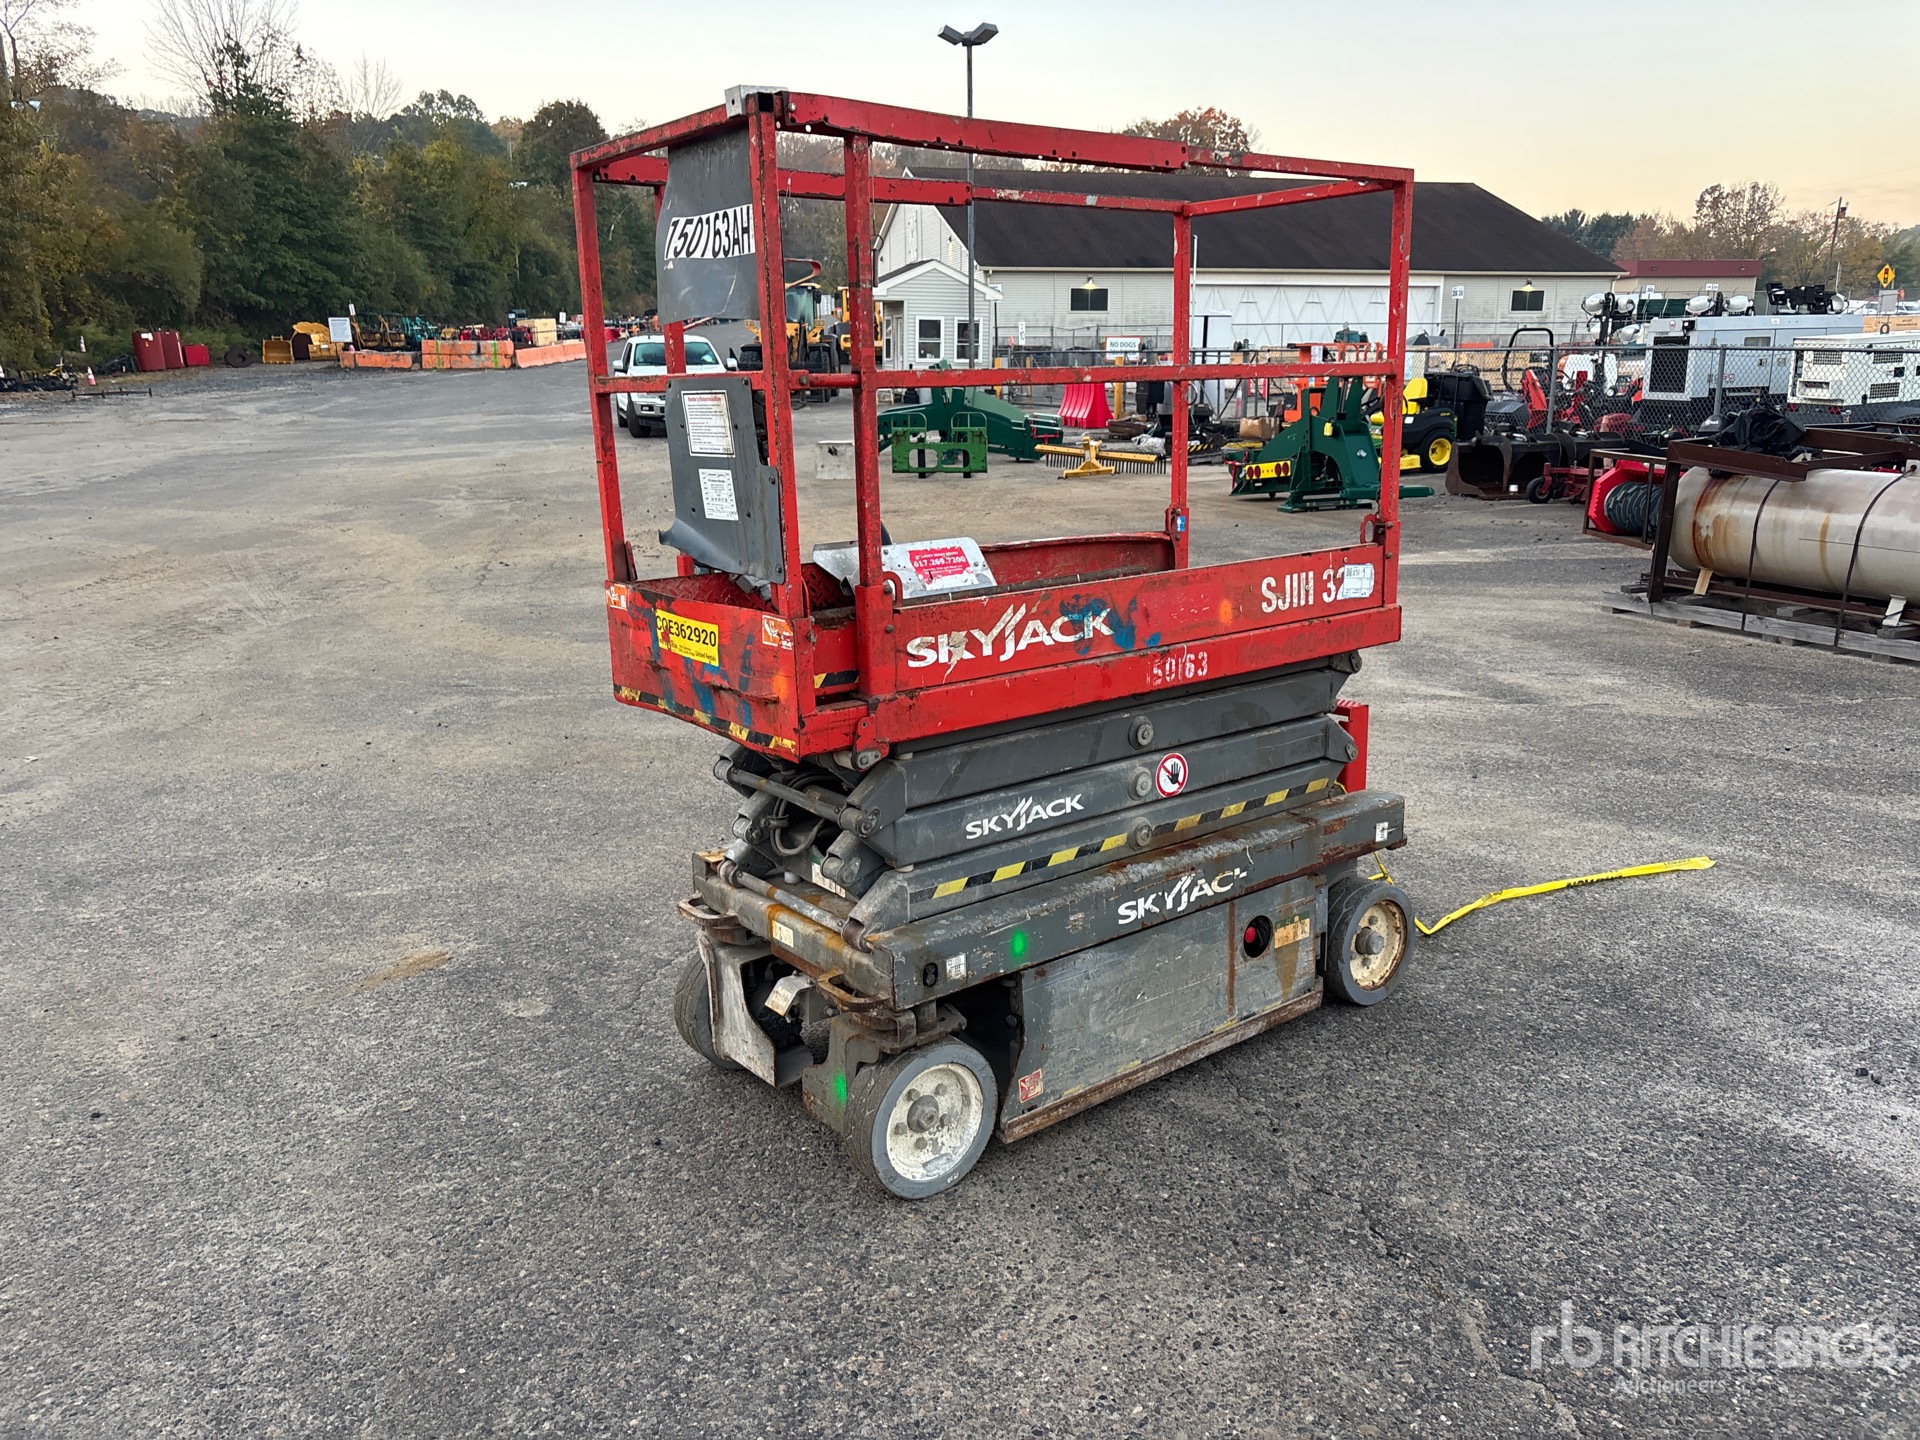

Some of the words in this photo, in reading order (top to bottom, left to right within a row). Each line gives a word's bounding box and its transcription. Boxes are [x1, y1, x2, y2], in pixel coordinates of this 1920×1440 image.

[665, 205, 751, 259] 150163AH
[913, 555, 966, 568] 617.269.7200
[906, 603, 1114, 668] SKYJACK
[965, 793, 1085, 839] SKYJACK
